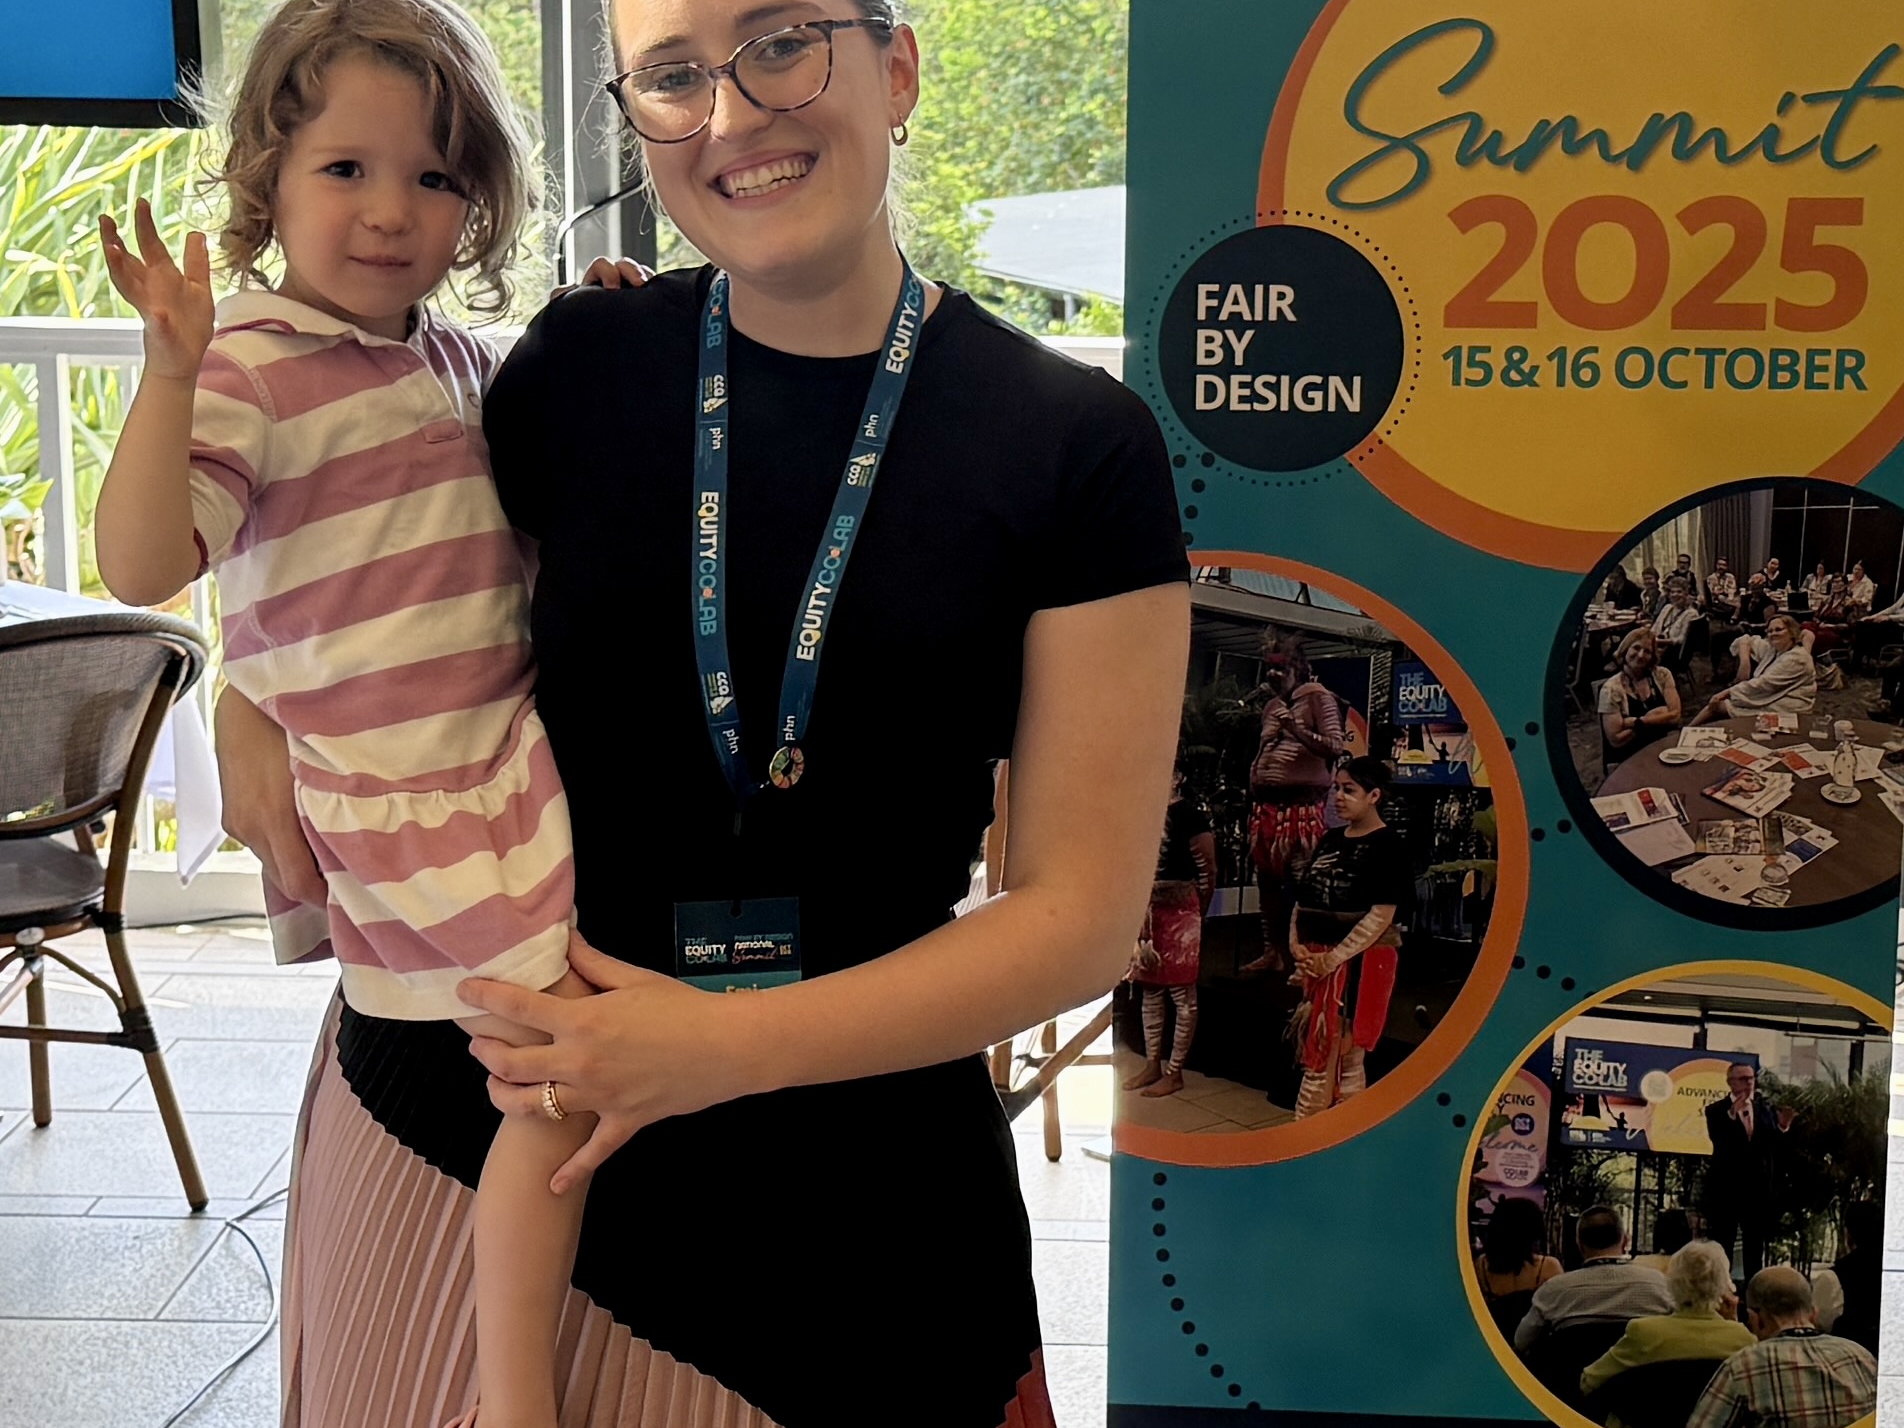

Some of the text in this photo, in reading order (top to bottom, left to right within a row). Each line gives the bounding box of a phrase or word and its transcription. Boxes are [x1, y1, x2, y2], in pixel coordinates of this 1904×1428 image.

[1442, 193, 1870, 334] 2025
[1195, 282, 1298, 323] FAIR
[1195, 328, 1256, 367] BY
[1613, 344, 1870, 392] OCTOBER
[1193, 374, 1363, 415] DESIGN
[709, 427, 724, 450] phn
[864, 413, 880, 439] phn
[1399, 672, 1425, 686] THE
[1399, 684, 1445, 700] EQUITY
[722, 728, 740, 755] phn
[783, 715, 796, 742] phn
[684, 944, 727, 956] EQUITY
[1573, 1058, 1627, 1075] EQUITY
[1575, 1048, 1603, 1060] THE
